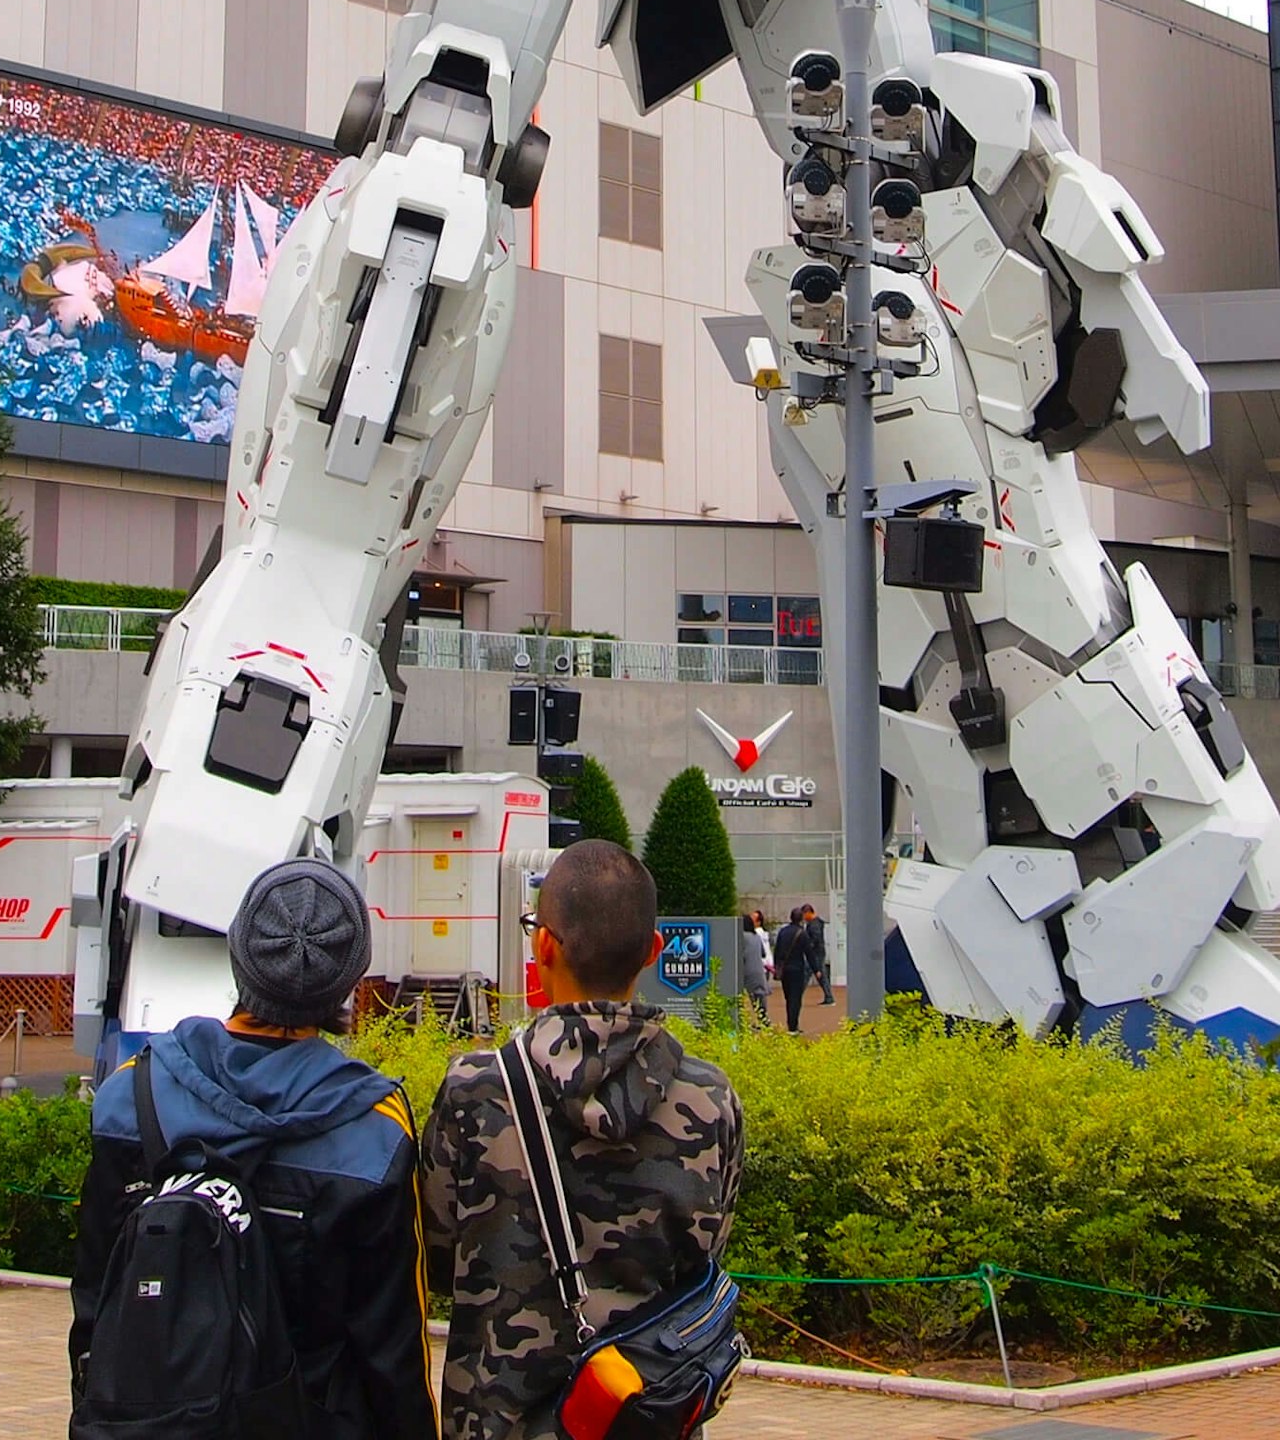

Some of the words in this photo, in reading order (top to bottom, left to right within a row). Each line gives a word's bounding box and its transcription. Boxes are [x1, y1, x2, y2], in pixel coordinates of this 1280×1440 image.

[705, 774, 763, 797] UNDAM
[766, 774, 816, 799] Café
[664, 962, 703, 974] GUNDAM
